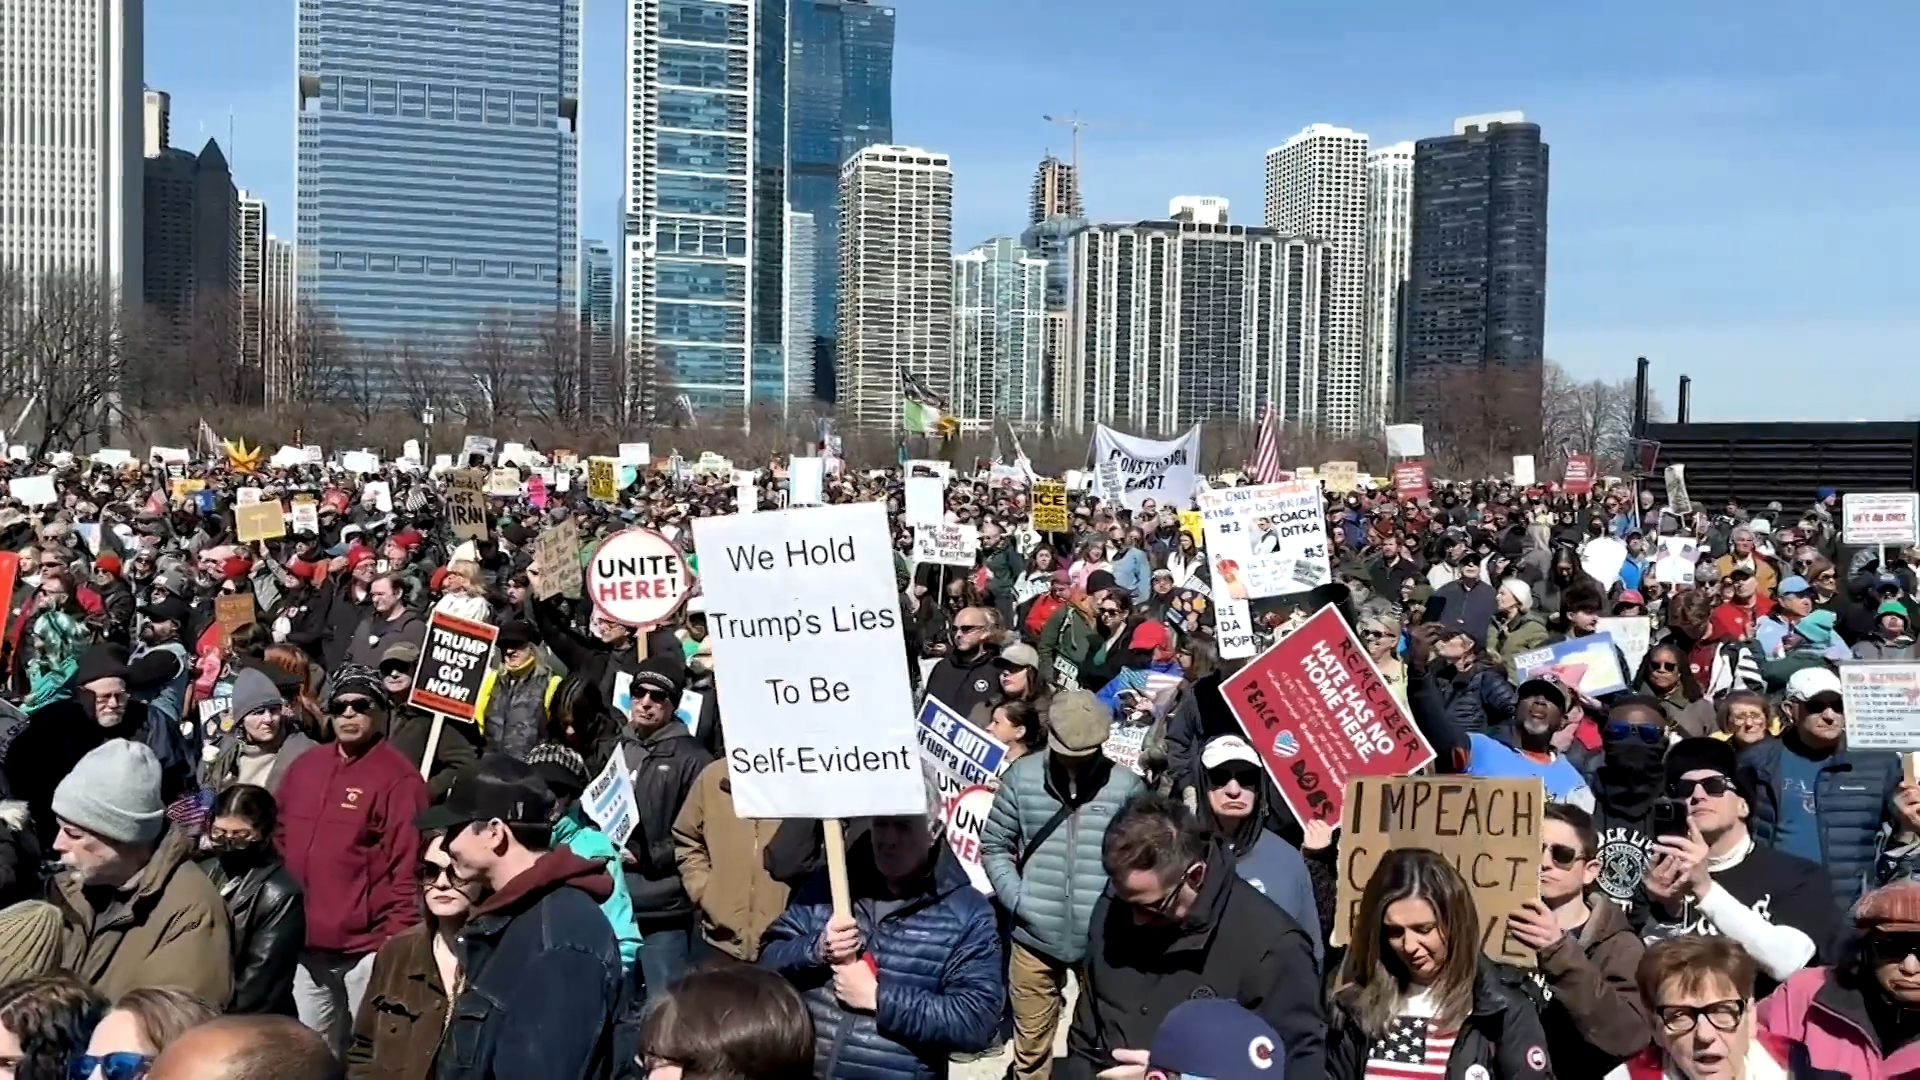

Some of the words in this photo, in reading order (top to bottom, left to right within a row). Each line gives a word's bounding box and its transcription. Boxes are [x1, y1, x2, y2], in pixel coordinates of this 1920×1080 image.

[1034, 493, 1065, 506] ICE
[1225, 489, 1251, 501] ONLY
[451, 506, 484, 526] IRAN
[1204, 506, 1234, 520] KING
[1271, 507, 1317, 525] COACH
[1281, 523, 1321, 538] DITKA
[727, 543, 774, 572] We
[785, 536, 856, 568] Hold
[1303, 543, 1325, 558] #3
[598, 554, 678, 578] UNITE
[599, 577, 678, 601] HERE!
[709, 608, 822, 642] Trump's
[831, 604, 895, 633] Lies
[1220, 619, 1241, 632] DA
[432, 628, 489, 656] TRUMP
[431, 645, 480, 670] MUST
[438, 665, 464, 683] GO
[1300, 653, 1345, 711] HOME
[425, 678, 471, 702] NOW!
[765, 678, 800, 706] To
[810, 677, 850, 703] Be
[1312, 639, 1347, 686] HATE
[1342, 684, 1376, 723] HAS
[1366, 721, 1395, 756] NO
[1339, 636, 1420, 762] REMEMBER
[1242, 679, 1280, 730] PEACE
[930, 709, 956, 740] ICE
[952, 728, 991, 765] OUT!
[732, 745, 912, 775] Self-Evident
[1351, 780, 1533, 837] IMPEACH
[1248, 1035, 1275, 1070] C
